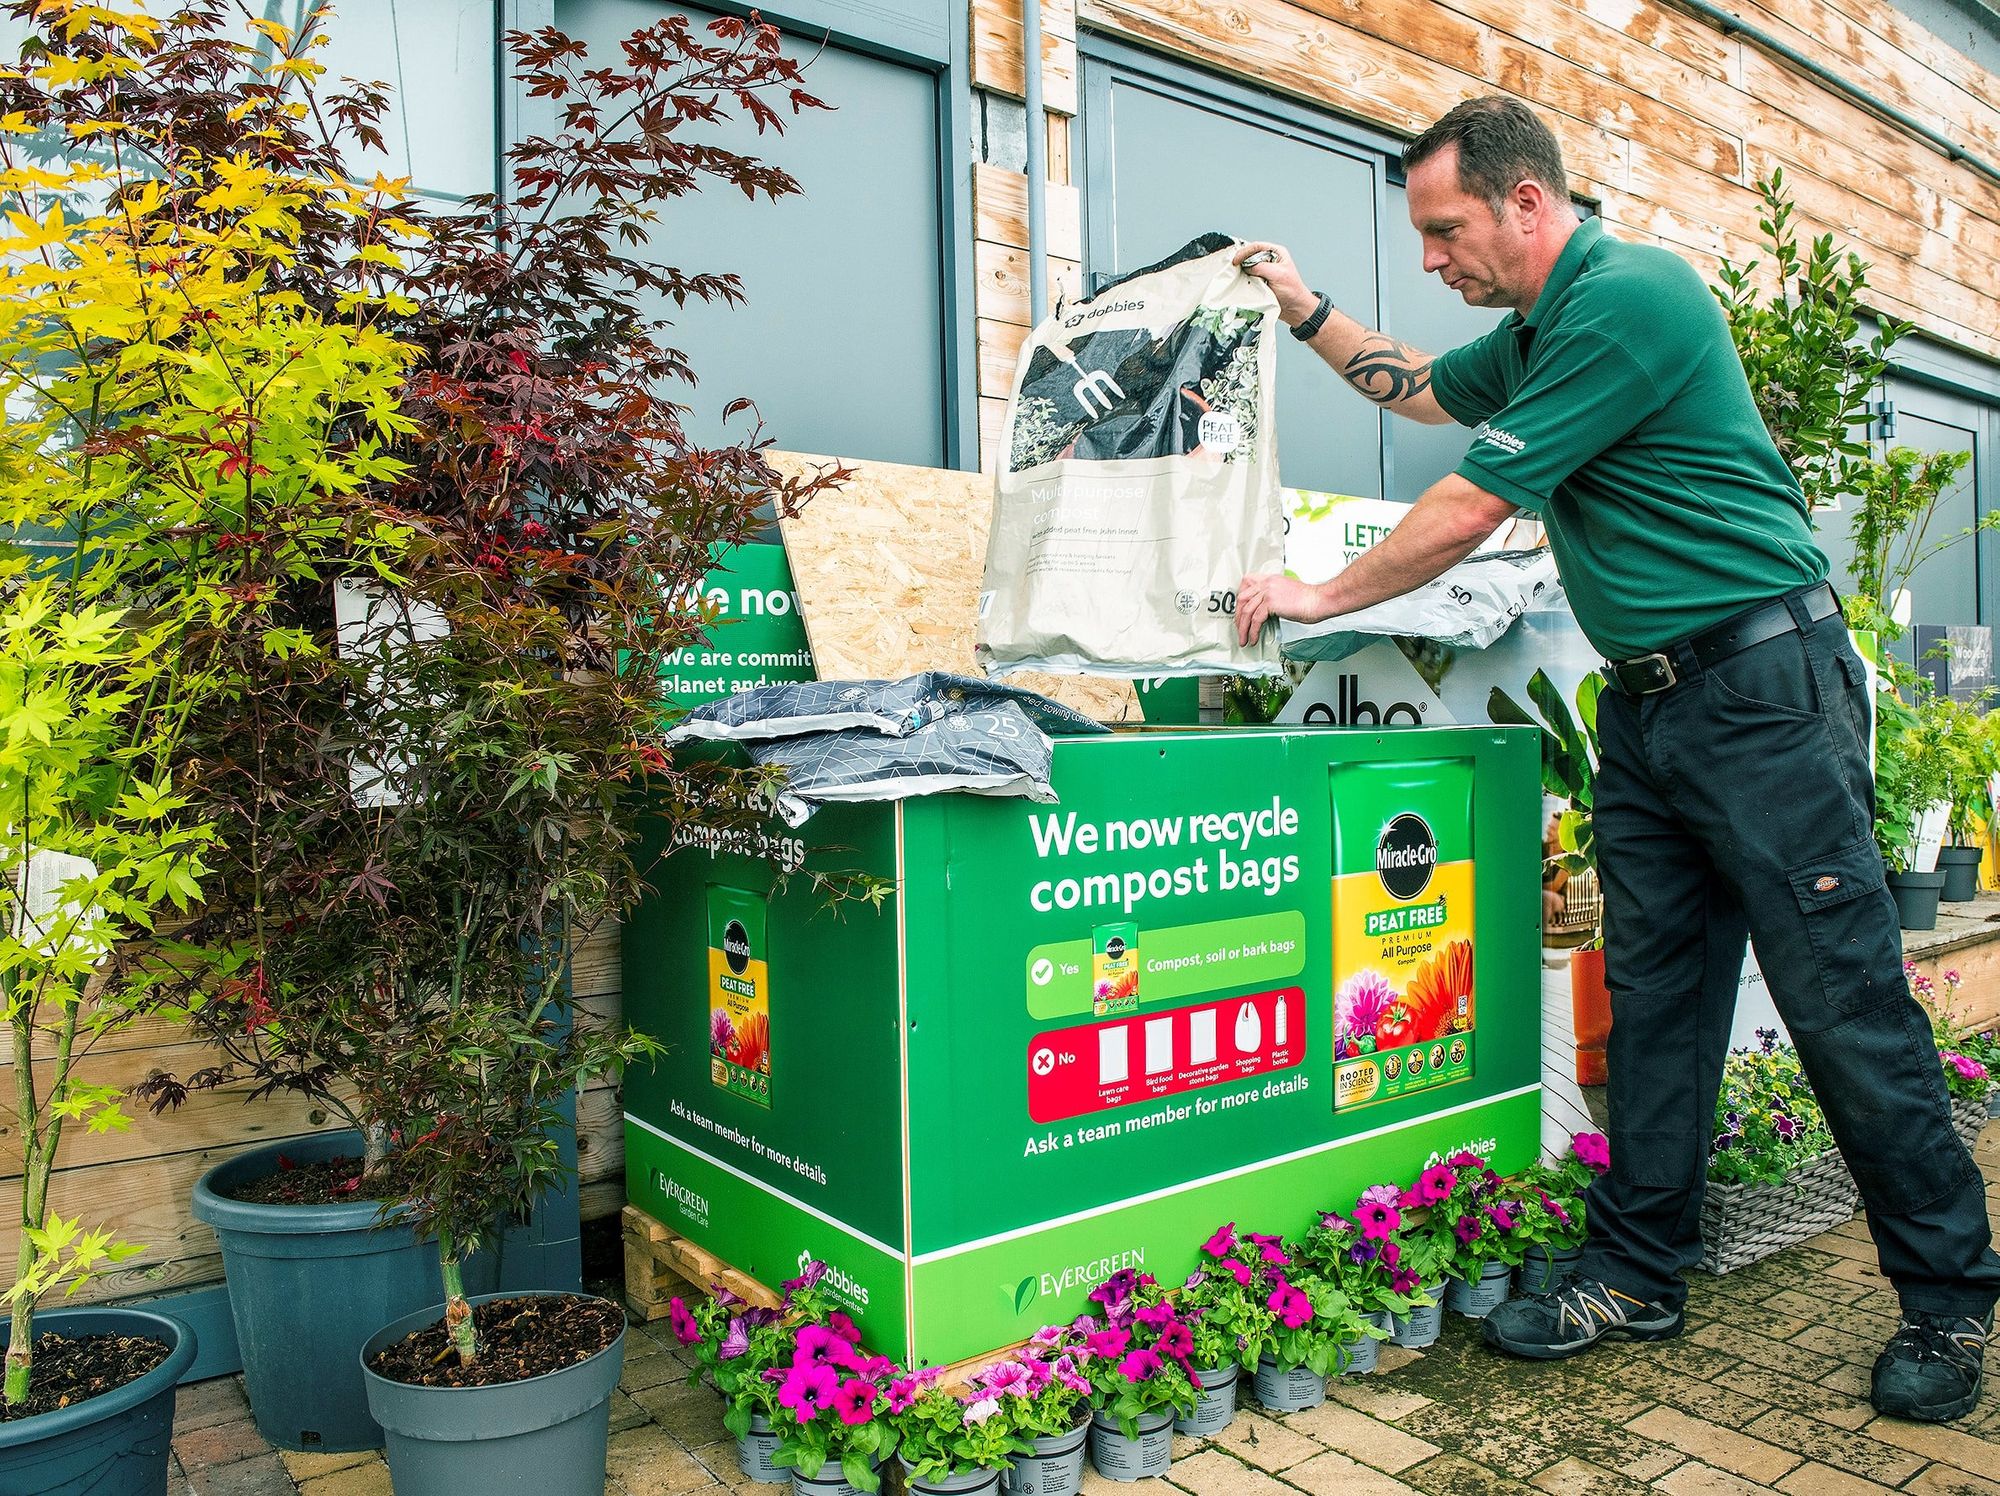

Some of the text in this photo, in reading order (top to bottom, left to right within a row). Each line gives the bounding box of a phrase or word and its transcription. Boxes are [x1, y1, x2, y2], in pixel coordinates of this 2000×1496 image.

[1087, 299, 1145, 320] dobbies
[1202, 419, 1235, 434] PEAT
[1202, 431, 1235, 445] FREE
[1489, 427, 1526, 450] dobbies
[1064, 527, 1081, 536] peat
[1082, 526, 1098, 535] free
[1207, 590, 1236, 615] 50
[1447, 584, 1473, 606] 50
[663, 647, 812, 667] We are commit
[661, 674, 726, 698] planet
[730, 674, 766, 693] and
[1018, 693, 1042, 709] eed
[1041, 701, 1071, 721] sowing
[984, 714, 1020, 739] 25
[1028, 795, 1299, 858] We now recycle
[1376, 842, 1438, 870] Miracle-Gro
[1030, 848, 1300, 914] compost bags
[1368, 904, 1444, 934] PEAT FREE
[1381, 931, 1433, 946] PREMIUM
[1147, 940, 1296, 974] Compost, soil or bark bags
[1381, 942, 1432, 960] All Purpose
[1059, 962, 1080, 976] Yes
[721, 975, 755, 997] PEAT FREE
[1747, 972, 1763, 989] pots
[1058, 1052, 1076, 1066] No
[1235, 1055, 1262, 1069] Shopping
[1271, 1049, 1289, 1059] Plastic
[1272, 1057, 1289, 1066] bottle
[1178, 1063, 1229, 1080] Decorative garden
[1241, 1064, 1256, 1074] bags
[1340, 1067, 1374, 1082] ROOTED
[1146, 1074, 1174, 1087] Bird food
[1189, 1073, 1219, 1086] stone bags
[1340, 1081, 1348, 1091] IN
[1348, 1074, 1374, 1089] SCIENCE
[1098, 1085, 1130, 1097] Lawn care
[1152, 1084, 1167, 1094] bags
[1106, 1095, 1122, 1104] bags
[1023, 1073, 1309, 1157] Ask a team member for more details
[670, 1098, 828, 1186] Ask a team member for more details
[660, 1172, 709, 1217] EVERGREEN
[1040, 1246, 1145, 1298] EVERGREEN
[823, 1286, 864, 1315] garden centres
